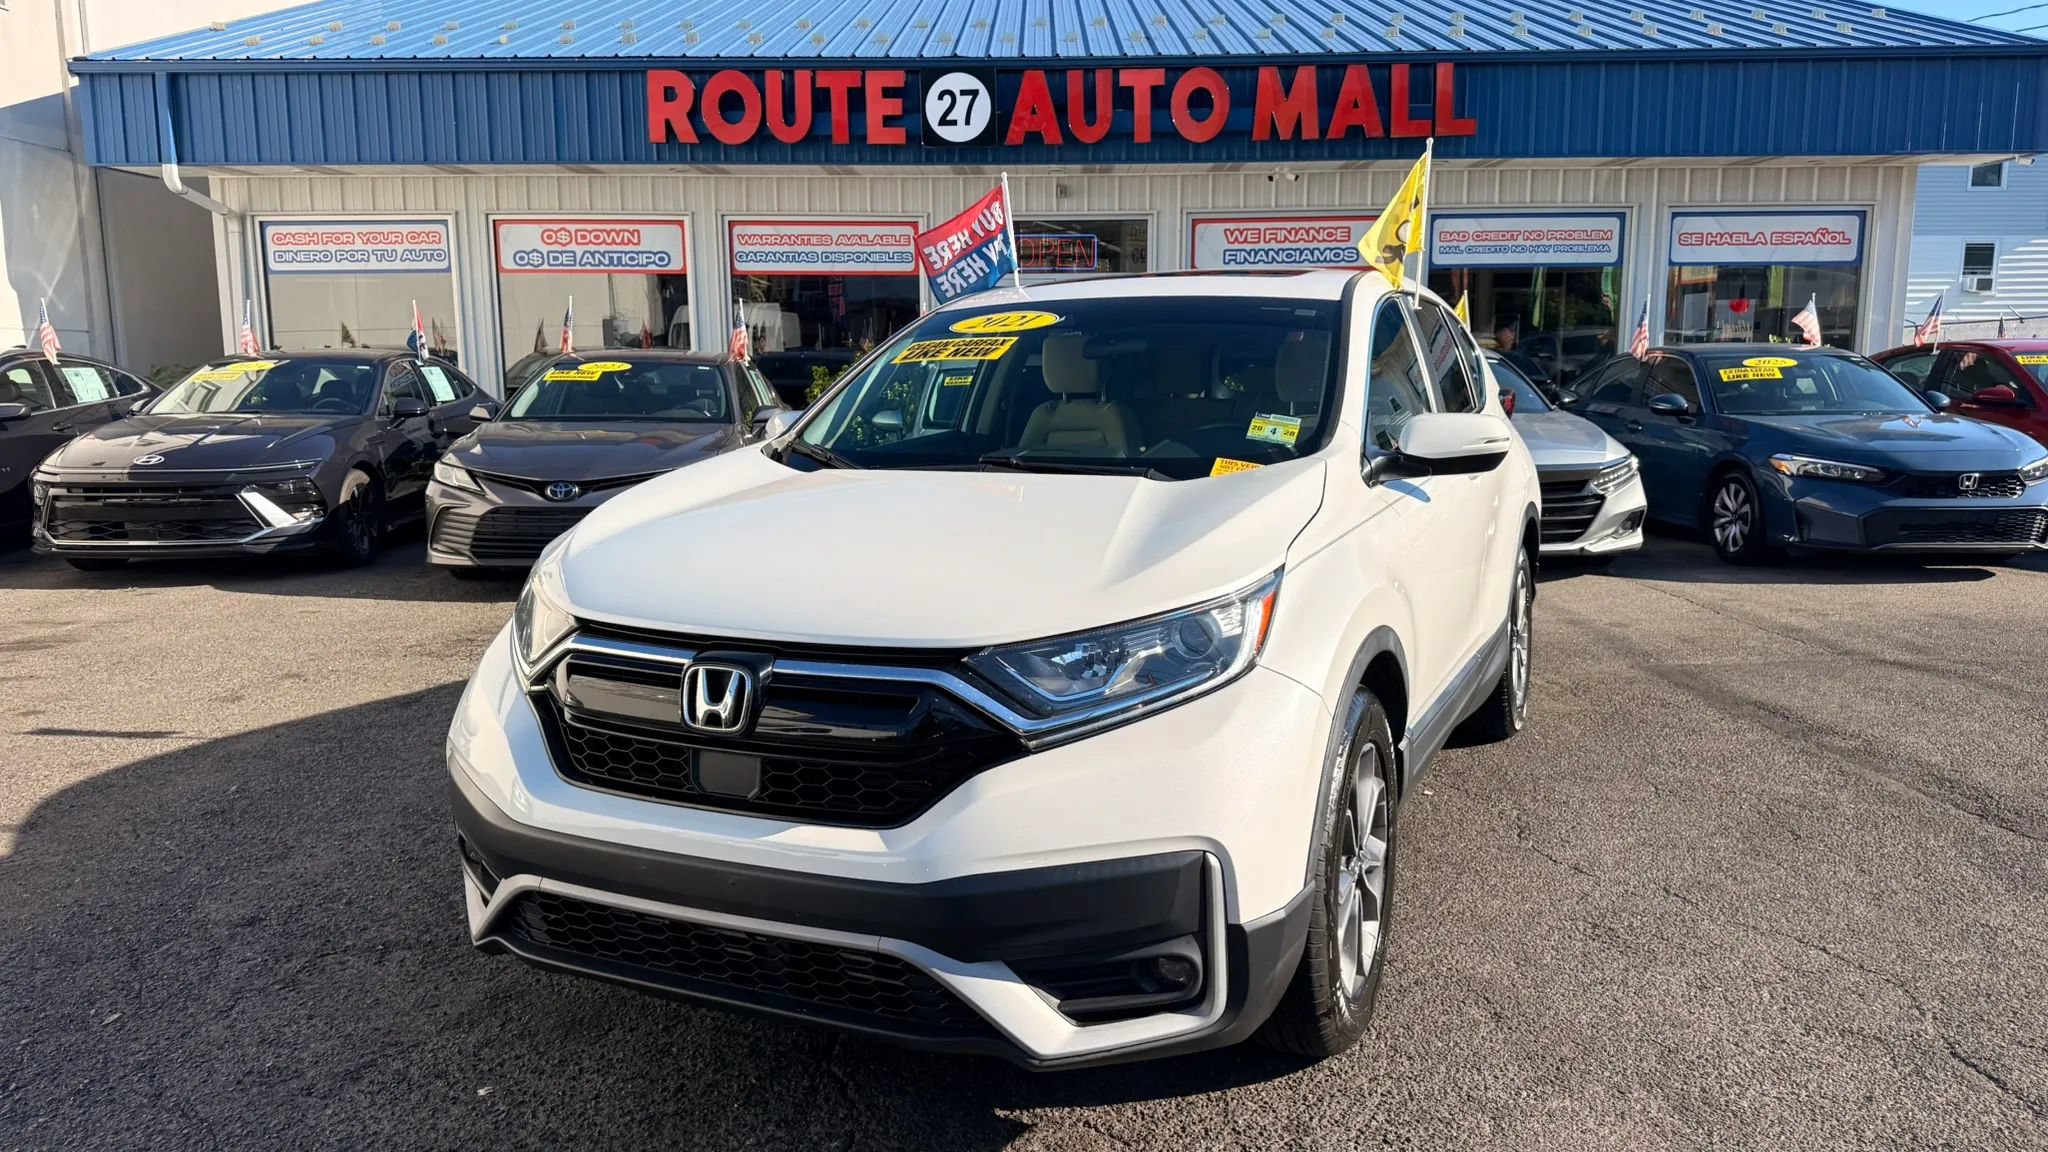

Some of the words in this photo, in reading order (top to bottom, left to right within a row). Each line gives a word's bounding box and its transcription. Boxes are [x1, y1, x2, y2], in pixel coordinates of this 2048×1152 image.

[647, 69, 907, 145] ROUTE
[936, 88, 981, 128] 27
[1003, 66, 1231, 146] AUTO
[1252, 61, 1477, 142] MALL
[272, 233, 318, 245] CASH
[322, 232, 354, 245] FOR
[357, 232, 403, 244] YOUR
[406, 231, 441, 244] CAR
[575, 229, 640, 245] DOWN
[737, 234, 833, 246] WARRANTIES
[835, 234, 911, 246] AVAILABLE
[1223, 228, 1260, 244] WE
[1263, 227, 1351, 244] FINANCE
[1440, 231, 1469, 242] BAD
[1471, 231, 1521, 242] CREDIT
[1524, 230, 1544, 241] NO
[1547, 230, 1612, 241] PROBLEM
[1678, 232, 1703, 246] SE
[1705, 231, 1767, 246] HABLA
[1770, 227, 1851, 245] ESPAÑOL
[274, 250, 332, 263] DINERO
[335, 250, 369, 262] POR
[372, 250, 397, 261] TU
[400, 249, 446, 261] AUTO
[1016, 238, 1096, 267] OPEN
[1223, 248, 1359, 265] FINANCIAMOS
[1439, 245, 1463, 254] MAL
[1465, 245, 1509, 254] CREDITO
[1510, 244, 1527, 254] NO
[1528, 244, 1552, 254] HAY
[1553, 244, 1611, 253] PROBLEMA
[547, 251, 576, 266] DE
[579, 251, 671, 267] ANTICIPO
[735, 251, 819, 263] GARANTIAS
[820, 252, 913, 263] DISPONIBLES
[968, 313, 1042, 329] 2021
[907, 339, 950, 351] CLEAN
[951, 337, 1011, 347] CARFAX
[902, 348, 943, 360] LIKE
[946, 346, 993, 358] NEW
